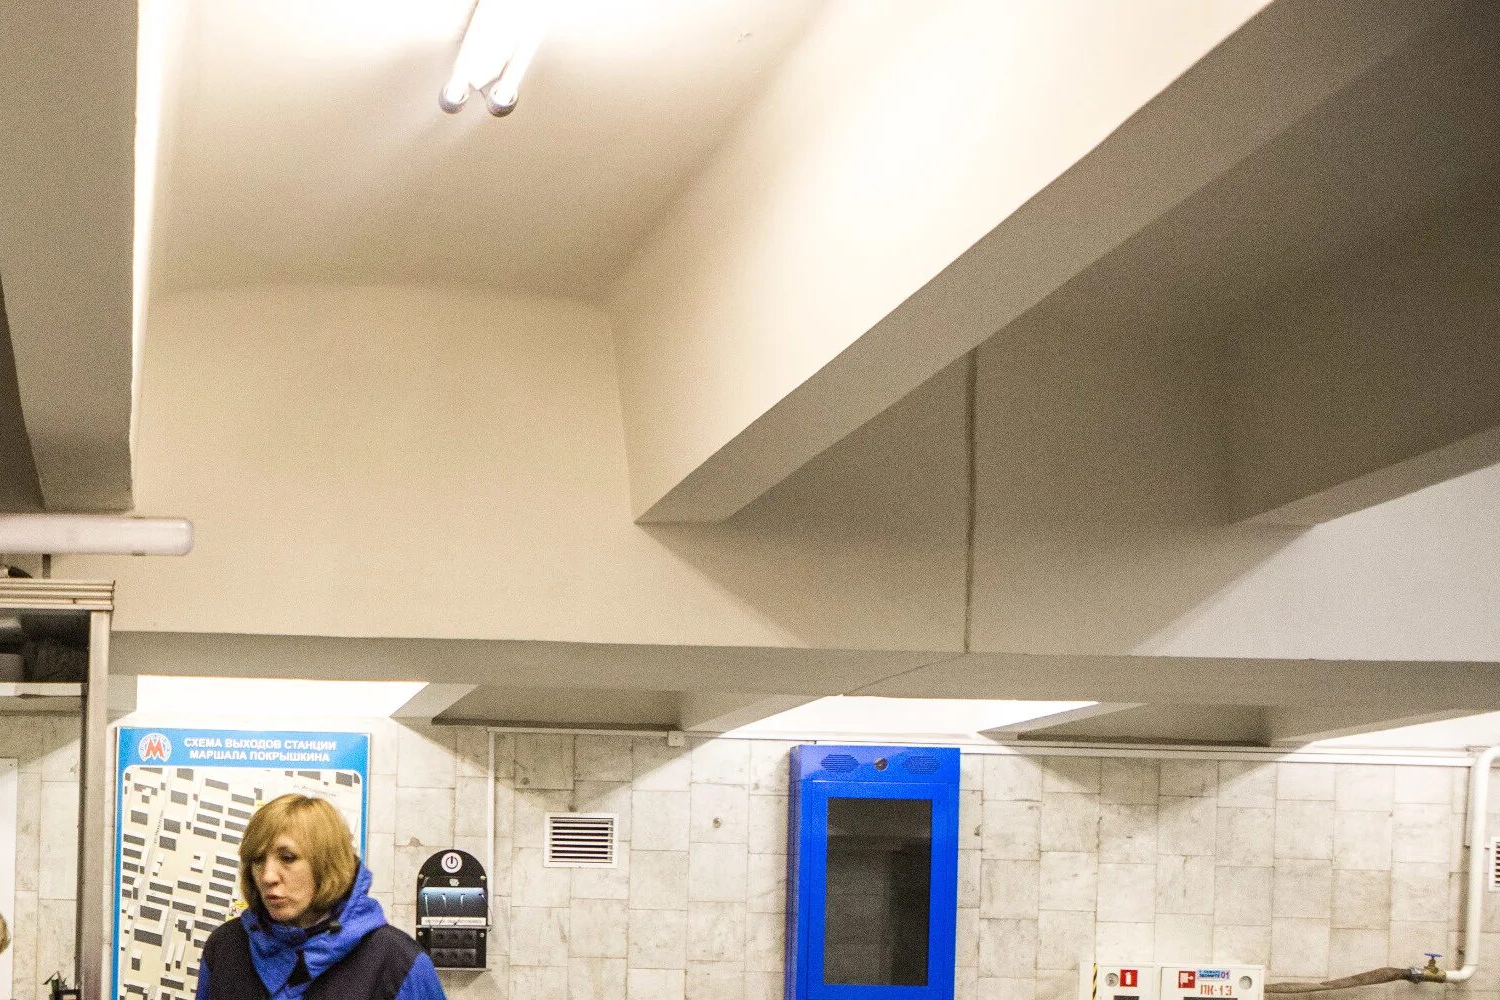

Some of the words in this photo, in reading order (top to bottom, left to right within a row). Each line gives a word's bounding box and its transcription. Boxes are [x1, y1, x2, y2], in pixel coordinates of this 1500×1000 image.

[183, 737, 223, 748] СХЕМА
[226, 738, 282, 750] ВЫХОДОВ
[284, 739, 336, 752] СТАНЦИИ
[189, 749, 247, 761] МАРШАЛА
[249, 750, 330, 762] ПОКРЫШКИНА
